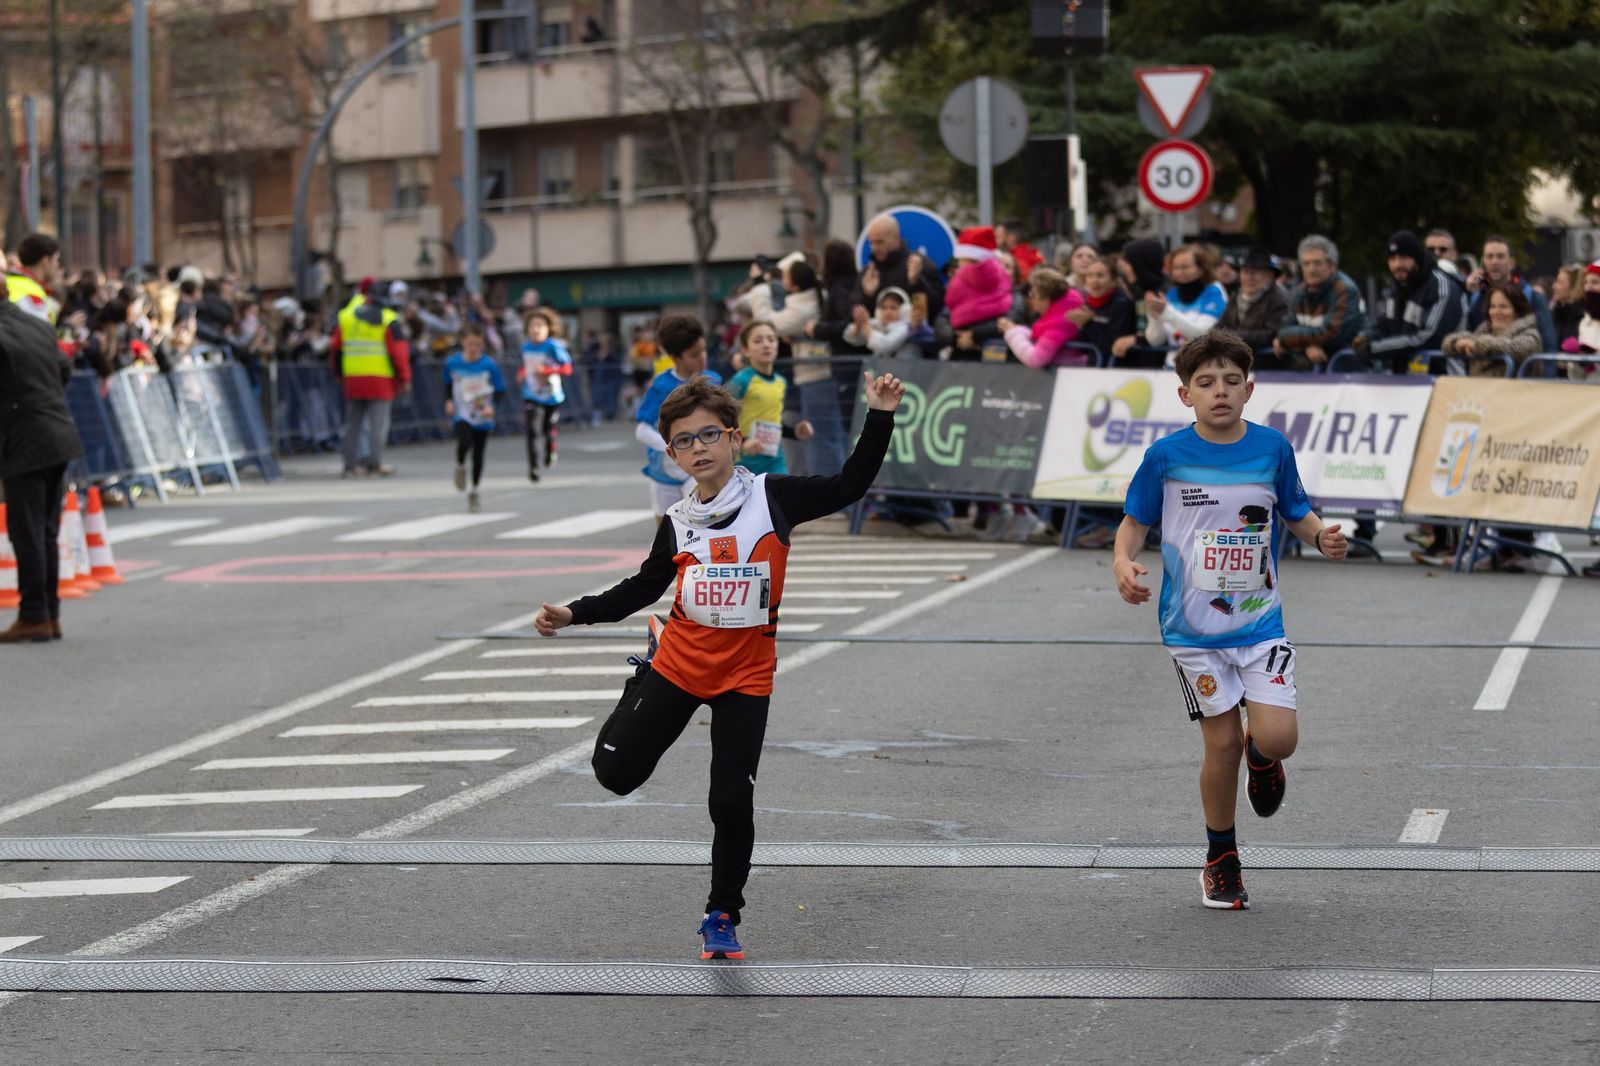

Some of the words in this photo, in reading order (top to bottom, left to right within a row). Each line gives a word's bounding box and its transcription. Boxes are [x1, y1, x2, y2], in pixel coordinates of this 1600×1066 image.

[1155, 165, 1193, 188] 30
[1104, 419, 1187, 446] SET
[1479, 434, 1589, 467] Ayuntamiento
[1323, 461, 1387, 481] fertilizantes
[1471, 467, 1490, 492] de
[1493, 469, 1578, 500] Salamanca
[1216, 535, 1264, 545] SETEL
[1204, 547, 1254, 571] 6795
[706, 567, 762, 578] SETEL
[694, 580, 751, 606] 6627
[1265, 645, 1292, 674] 17
